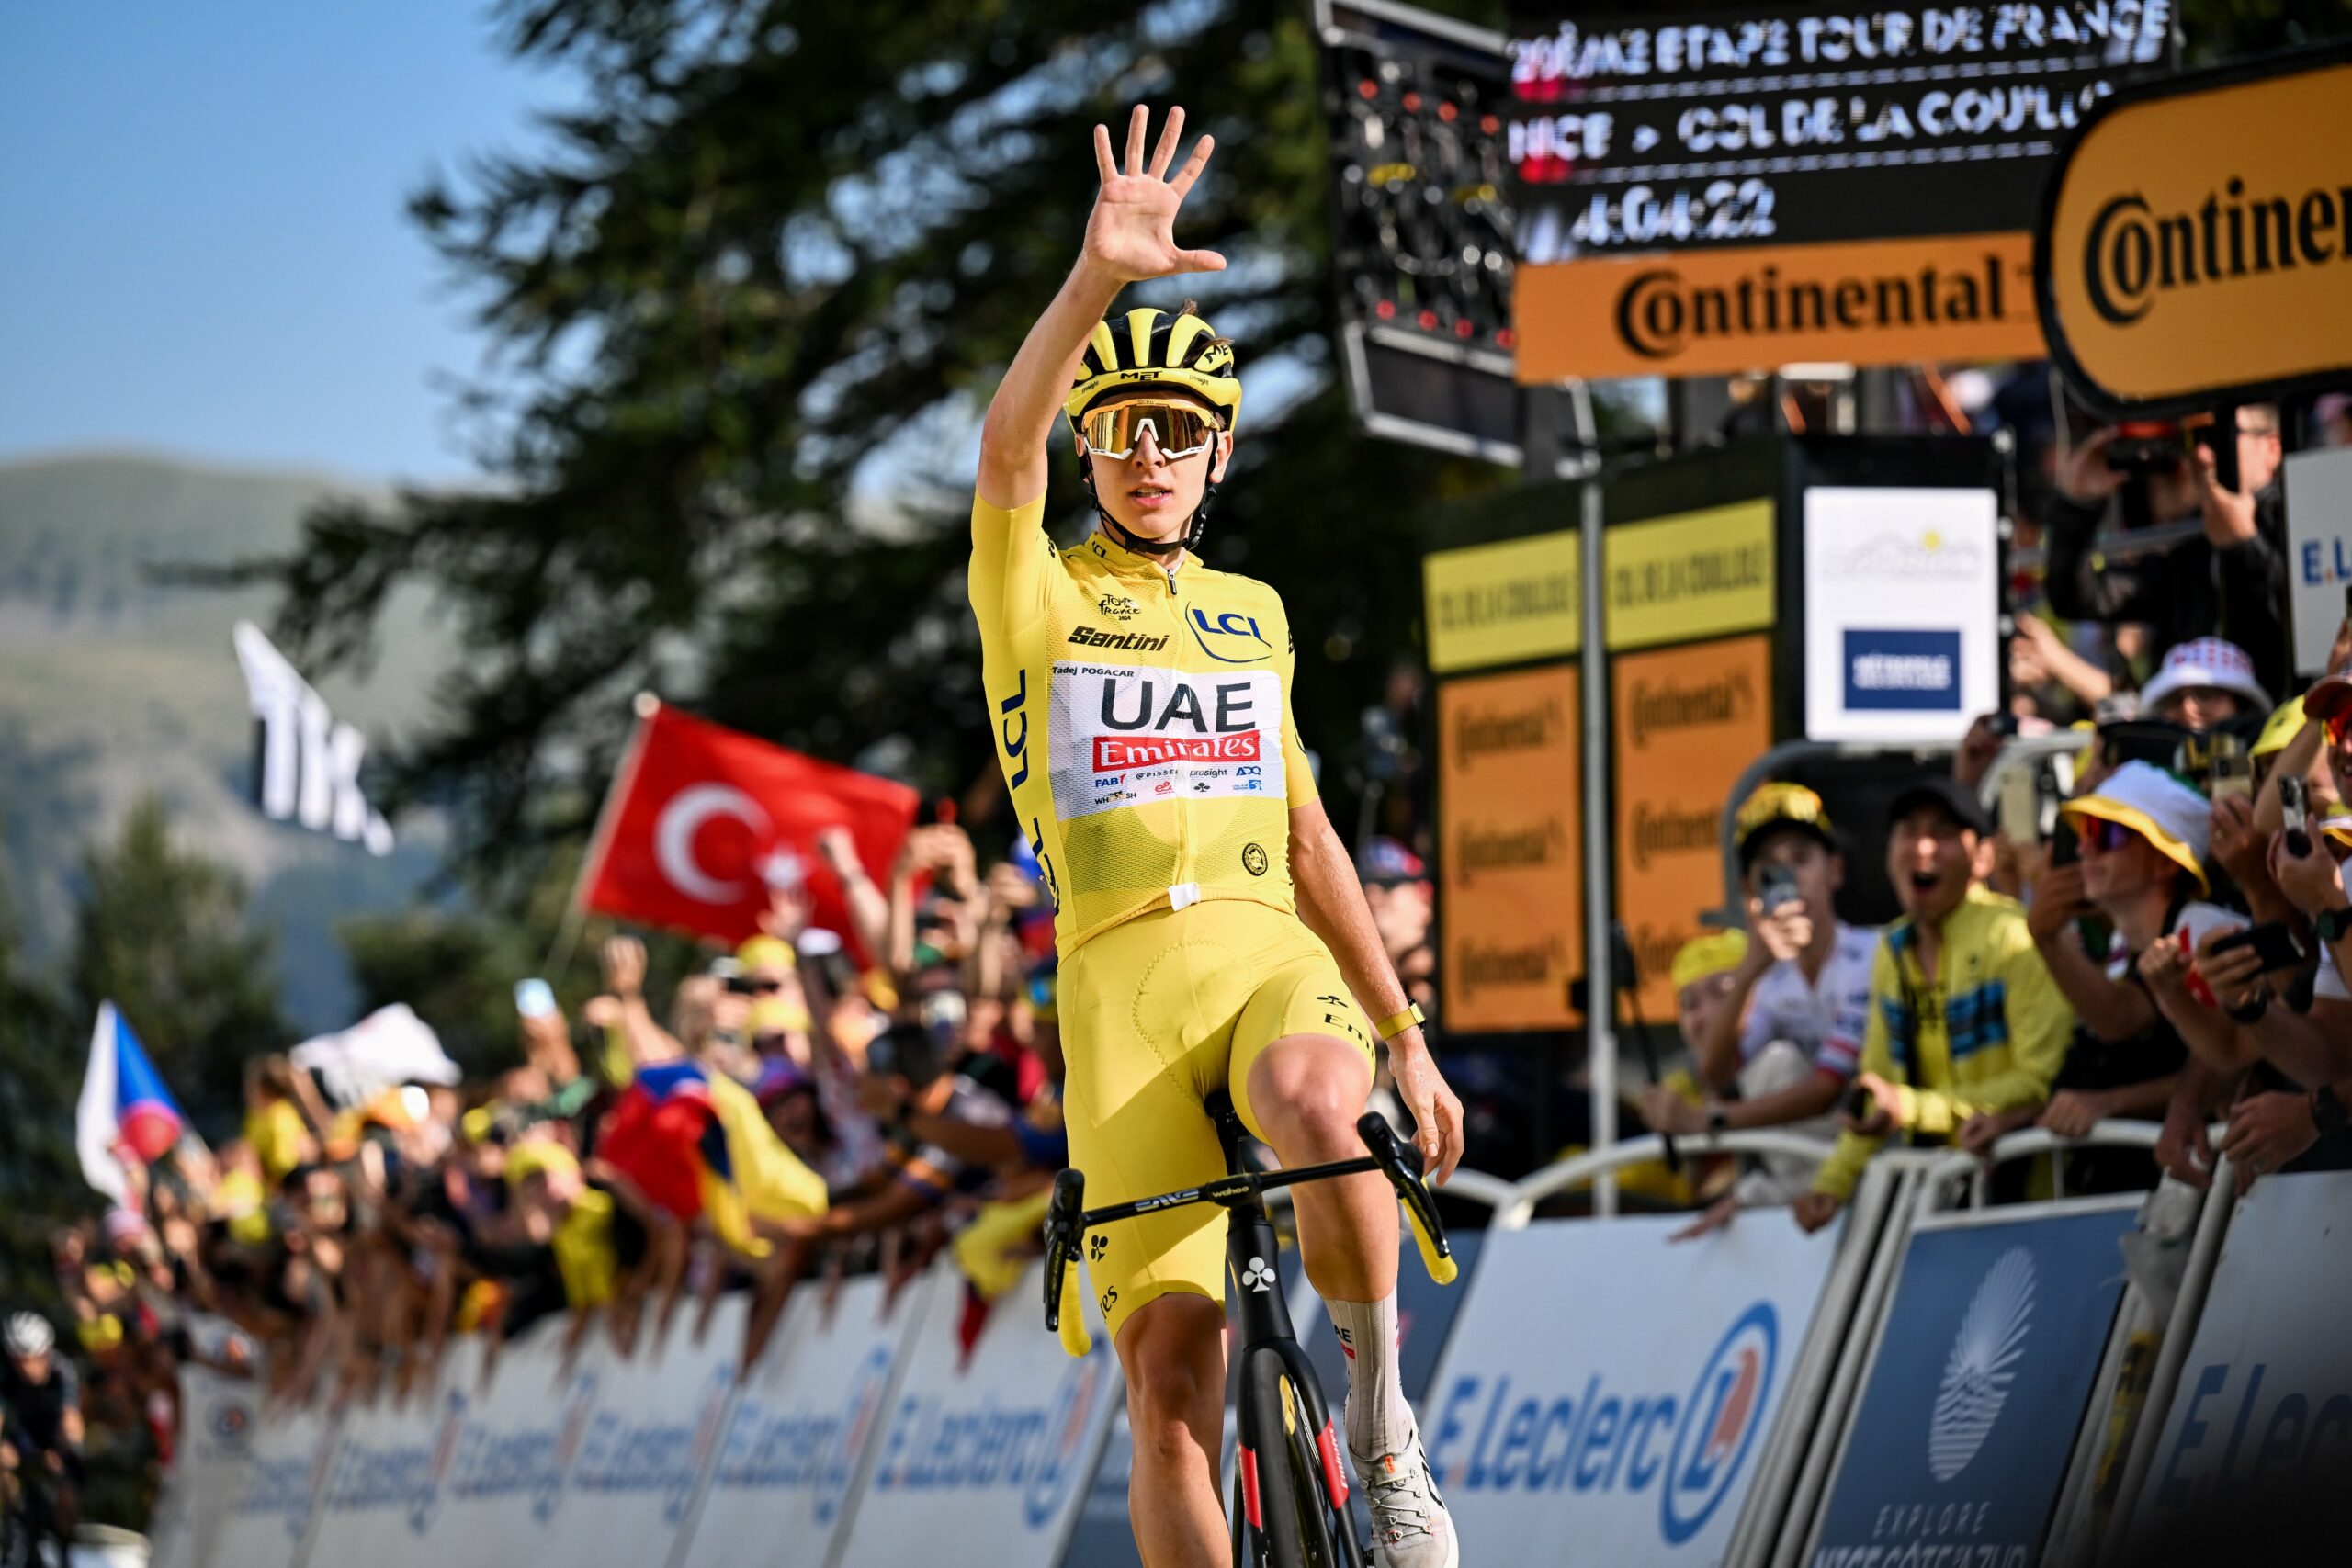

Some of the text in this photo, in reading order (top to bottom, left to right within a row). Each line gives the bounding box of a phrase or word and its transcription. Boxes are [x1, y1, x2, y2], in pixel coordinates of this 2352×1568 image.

[1797, 11, 1915, 62] TOUR
[1921, 7, 1984, 54] DE
[1990, 0, 2169, 51] FRANCE
[1508, 111, 1613, 164] NICE
[1678, 104, 1776, 152] COL
[1781, 96, 1846, 146] DE
[1849, 95, 1916, 142] LA
[1572, 178, 1776, 246] 4:04:22
[1616, 255, 2006, 358] Continental
[1120, 370, 1164, 381] MET
[1068, 626, 1170, 652] Santini
[1052, 667, 1135, 677] Tadej POGACAR
[1101, 678, 1256, 733] UAE
[1001, 669, 1029, 791] LCL
[1098, 738, 1256, 766] Emirates
[1095, 777, 1119, 788] FAB
[1190, 768, 1228, 778] presight
[1211, 1185, 1250, 1198] wahoo
[1425, 1371, 1678, 1495] E.Leclerc
[1871, 1501, 1991, 1540] EXPLORE
